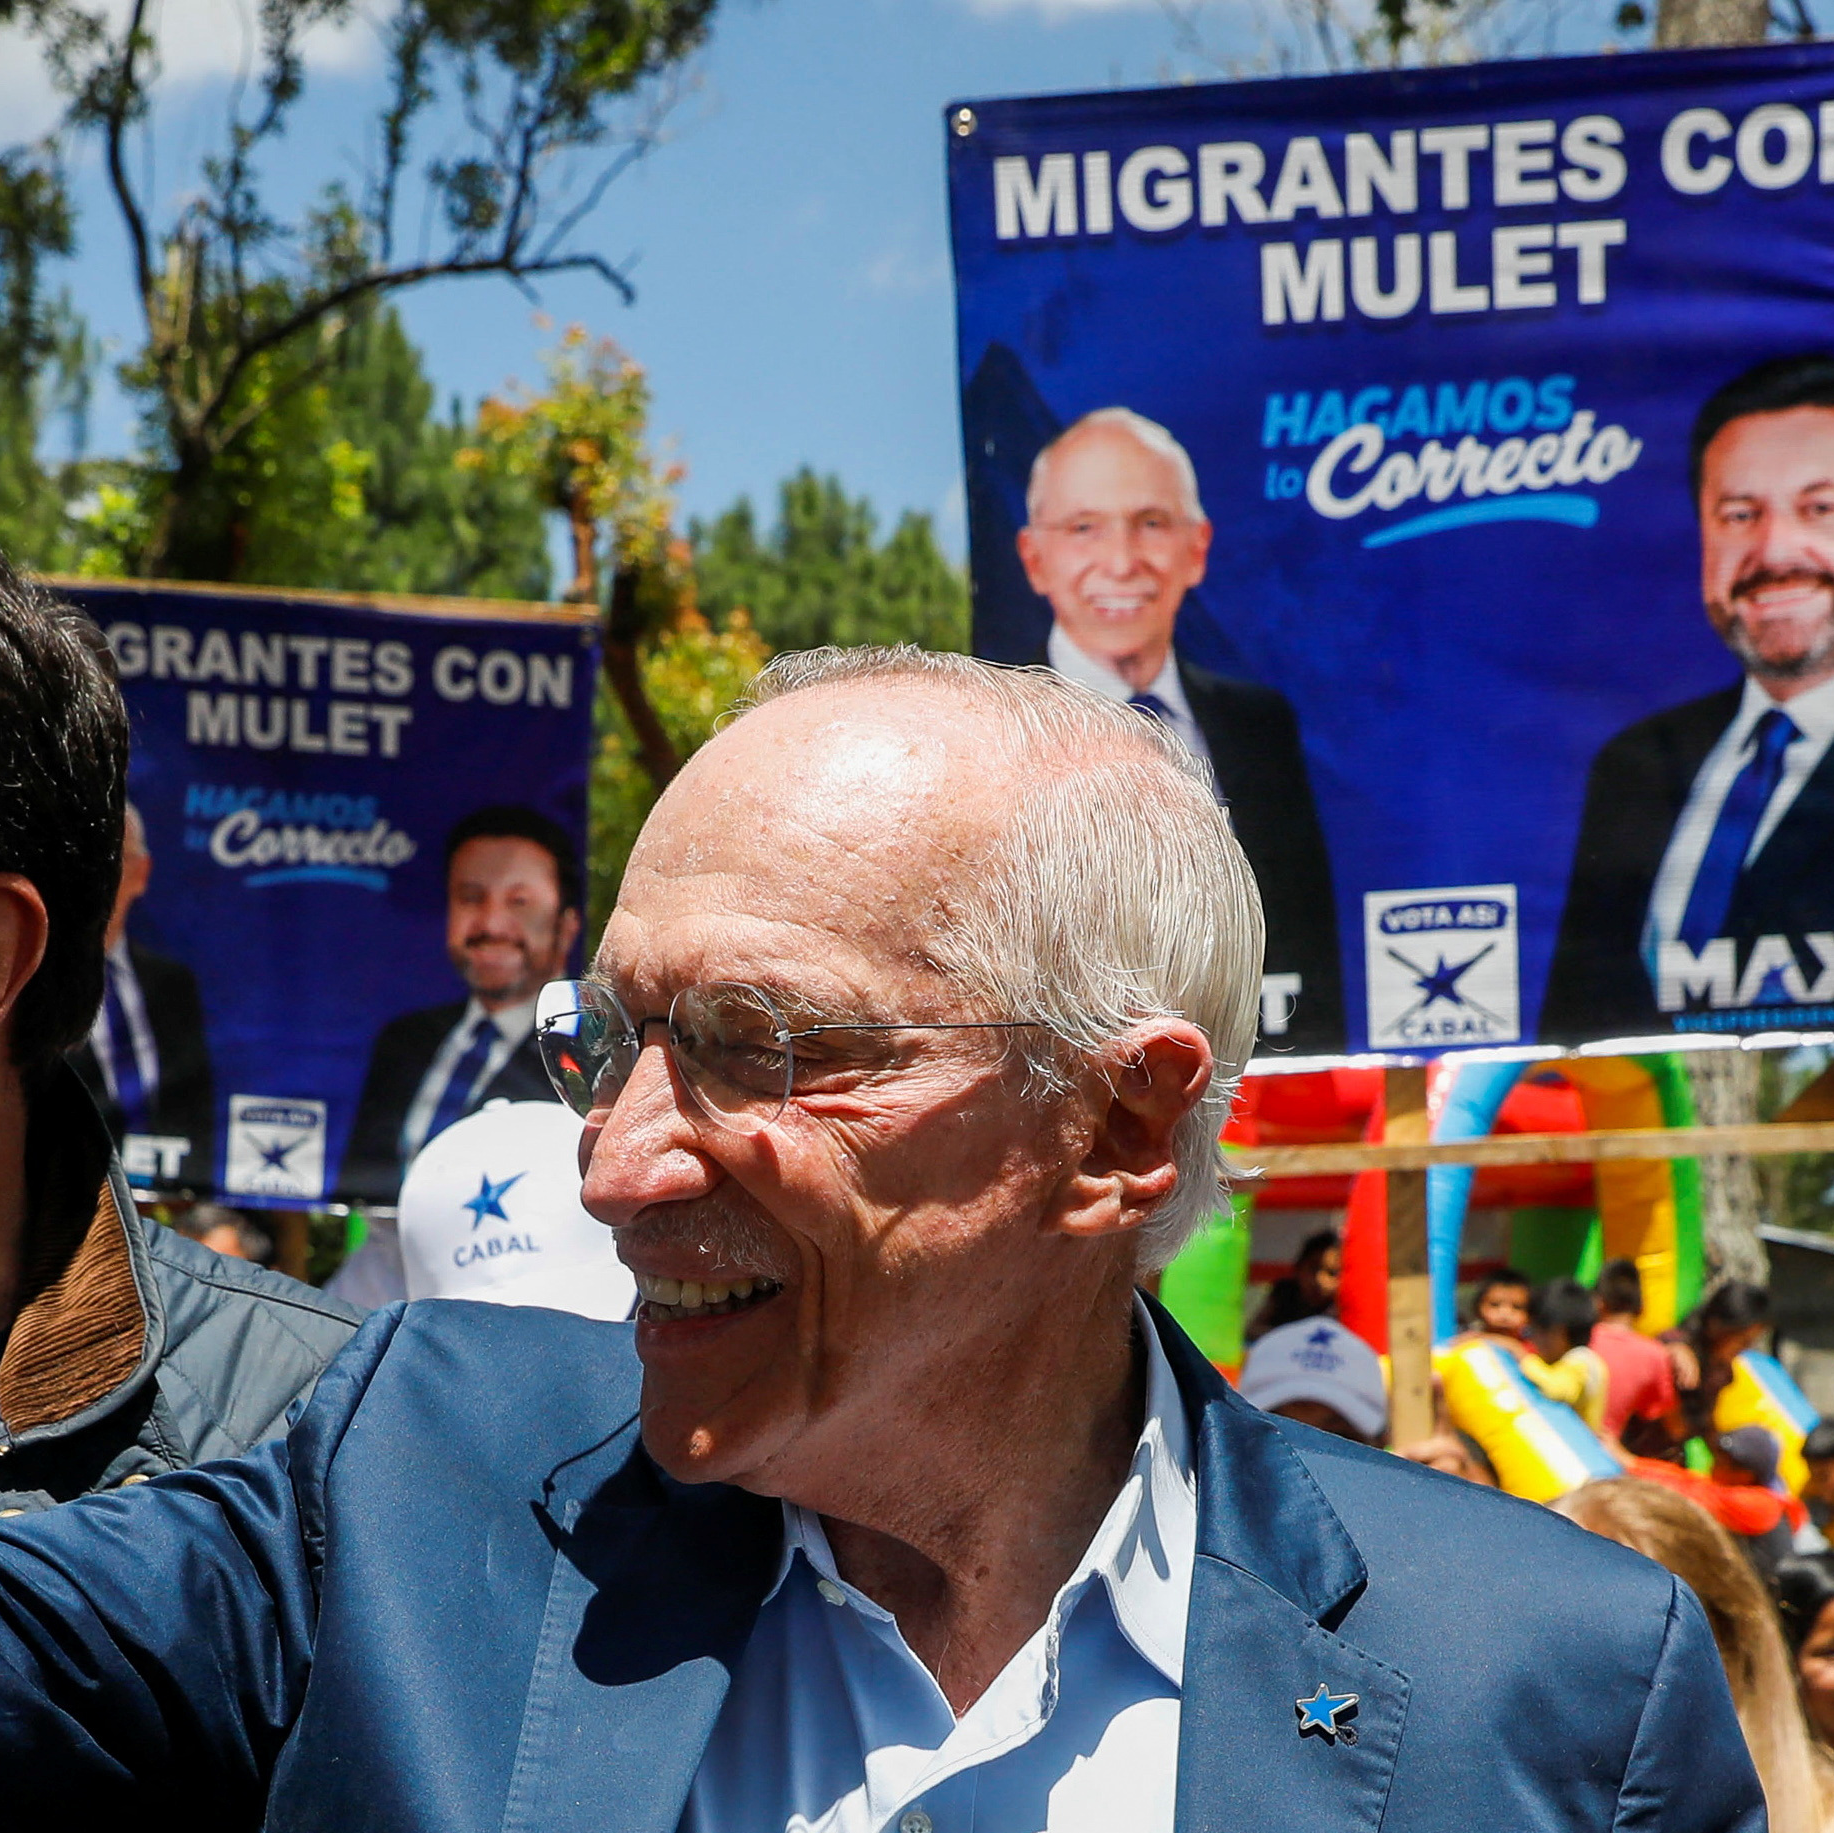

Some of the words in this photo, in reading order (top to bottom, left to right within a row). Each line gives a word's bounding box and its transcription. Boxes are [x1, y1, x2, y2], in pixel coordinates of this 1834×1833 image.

[993, 114, 1627, 240] MIGRANTES
[1260, 219, 1626, 326] MULET
[1262, 373, 1577, 448] HAGAMOS
[1265, 461, 1304, 500] lo
[1306, 409, 1643, 519] Correcto
[105, 621, 414, 697] GRANTES
[432, 646, 572, 707] CON
[185, 690, 414, 758] MULET
[209, 809, 417, 868] Correcto
[1384, 905, 1453, 931] VOTA
[452, 1233, 542, 1268] CABAL
